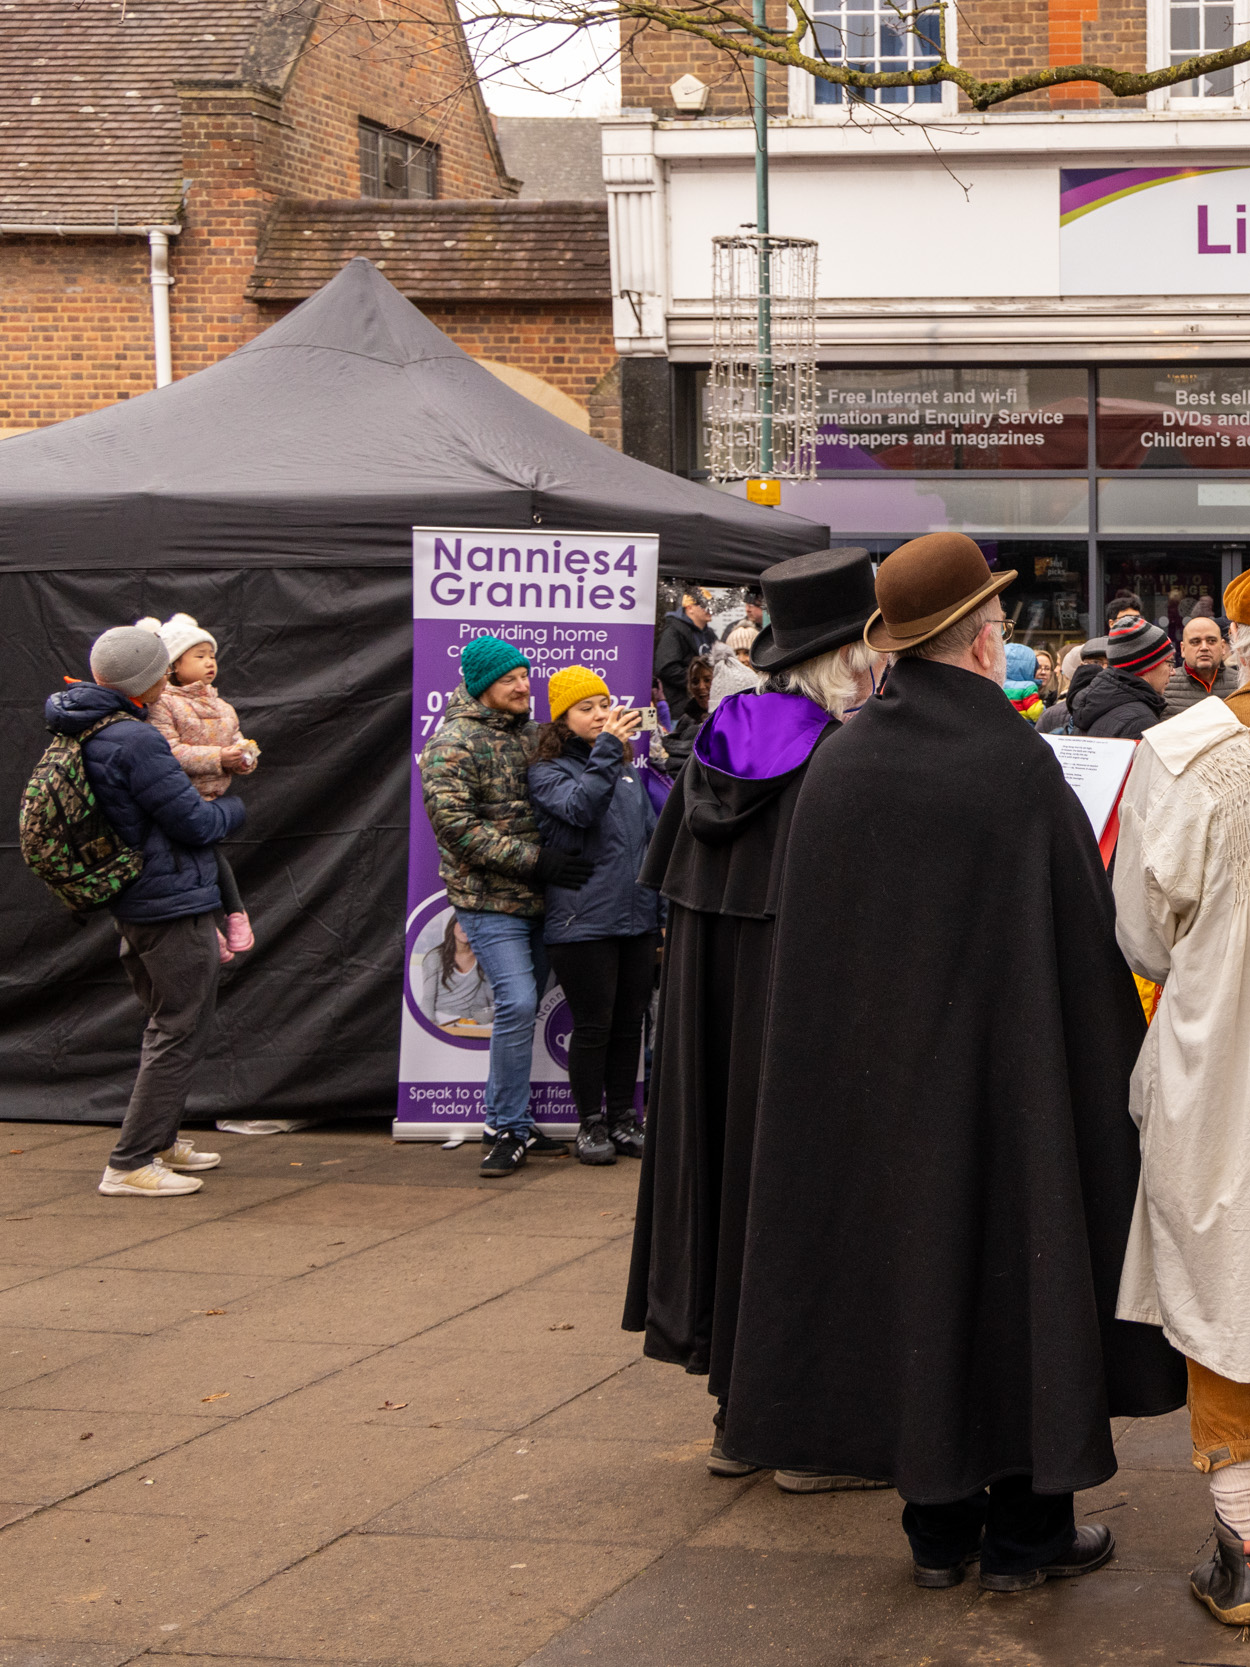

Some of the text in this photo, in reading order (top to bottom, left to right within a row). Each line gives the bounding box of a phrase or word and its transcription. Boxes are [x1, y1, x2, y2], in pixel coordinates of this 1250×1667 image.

[828, 388, 1017, 404] Free Internet and wi-fi
[1175, 390, 1216, 405] Best
[887, 410, 920, 425] and
[925, 410, 993, 428] Enquiry
[999, 409, 1064, 425] Service
[1163, 411, 1212, 427] DVDs
[1217, 411, 1250, 426] and
[913, 431, 945, 446] and
[951, 431, 1045, 449] magazines
[1140, 431, 1231, 448] Children's
[434, 537, 637, 578] Nannies4
[430, 572, 636, 610] Grannies
[459, 623, 608, 644] Providing home
[580, 646, 618, 661] and
[409, 1086, 452, 1101] Speak
[456, 1086, 469, 1099] to
[432, 1101, 472, 1117] today
[475, 1101, 487, 1114] fo
